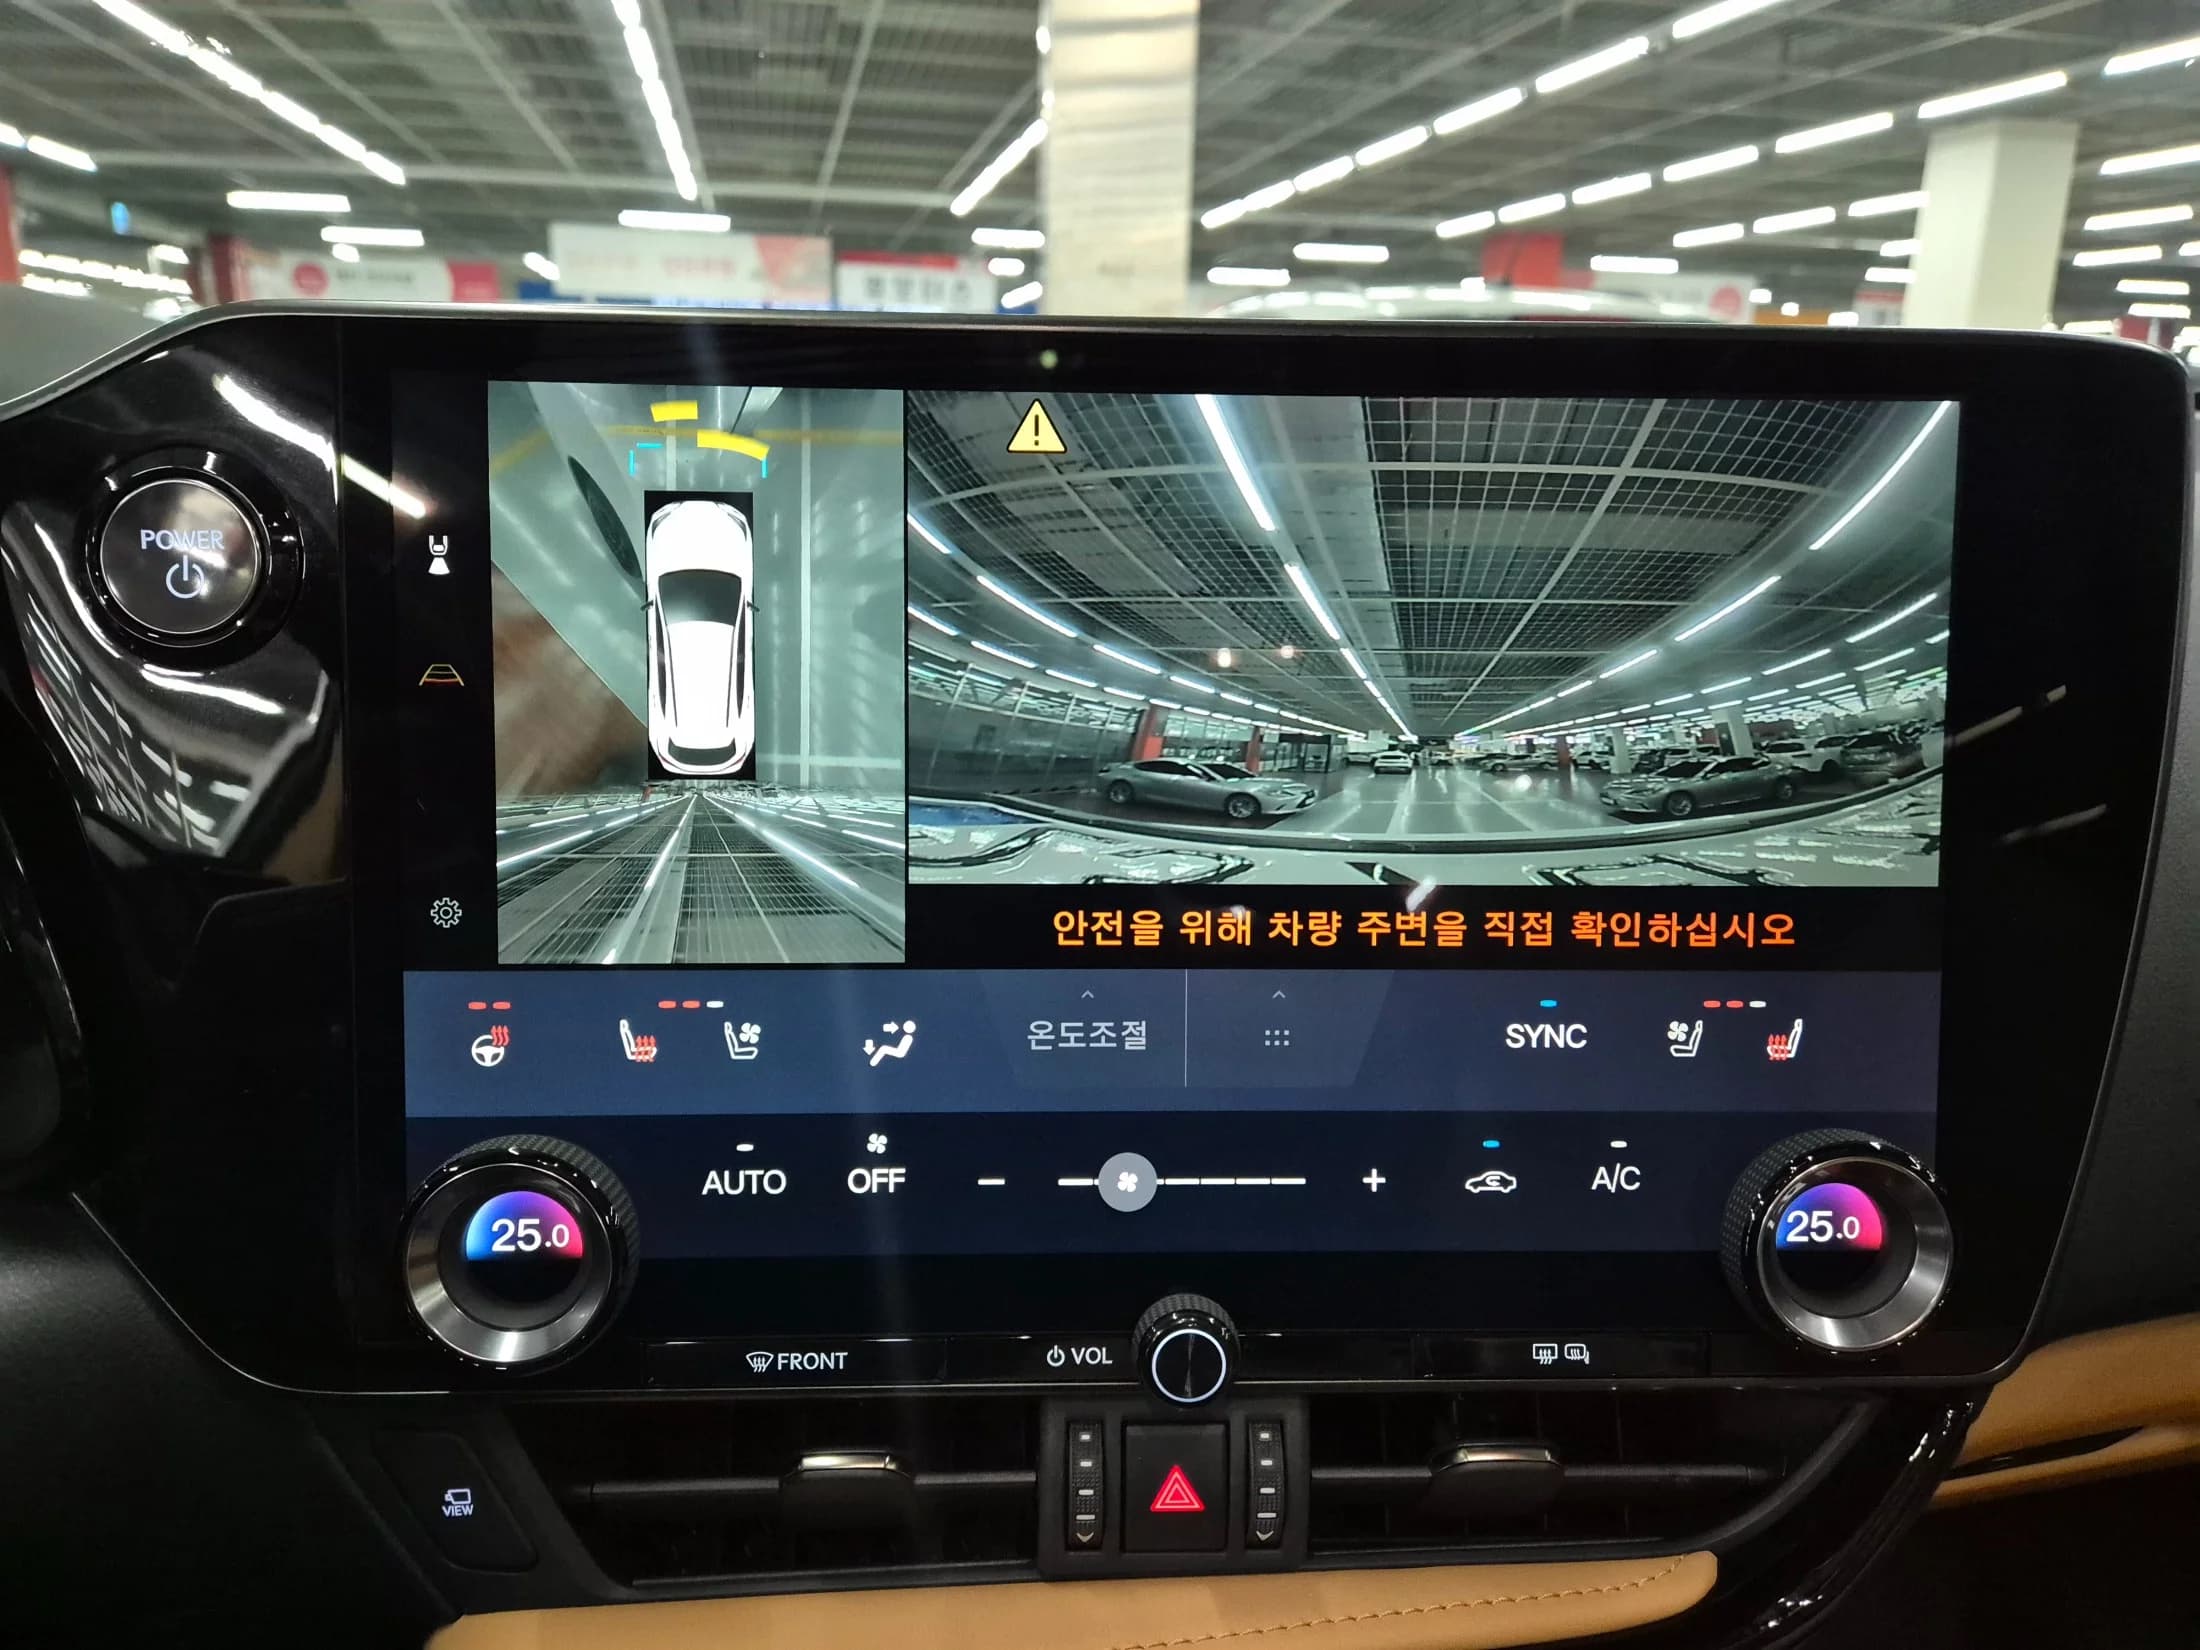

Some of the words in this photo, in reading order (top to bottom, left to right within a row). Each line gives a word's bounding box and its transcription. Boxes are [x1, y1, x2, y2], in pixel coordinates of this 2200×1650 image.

[140, 529, 225, 551] POWER
[1053, 909, 1164, 947] 안전을
[1179, 909, 1252, 947] 위해
[1268, 910, 1343, 947] 차량
[1357, 910, 1467, 947] 주변을
[1483, 911, 1553, 947] 직접
[1570, 911, 1796, 948] 확인하십시오
[1026, 1019, 1147, 1051] 온도조절
[1504, 1023, 1588, 1049] SYNC
[701, 1168, 787, 1196] AUTO
[847, 1167, 907, 1194] OFF
[1591, 1162, 1641, 1194] A/C
[490, 1218, 570, 1252] 25.0
[1786, 1209, 1861, 1243] 25.0
[777, 1351, 849, 1371] FRONT
[1070, 1347, 1113, 1366] VOL
[441, 1504, 474, 1517] VIEW
